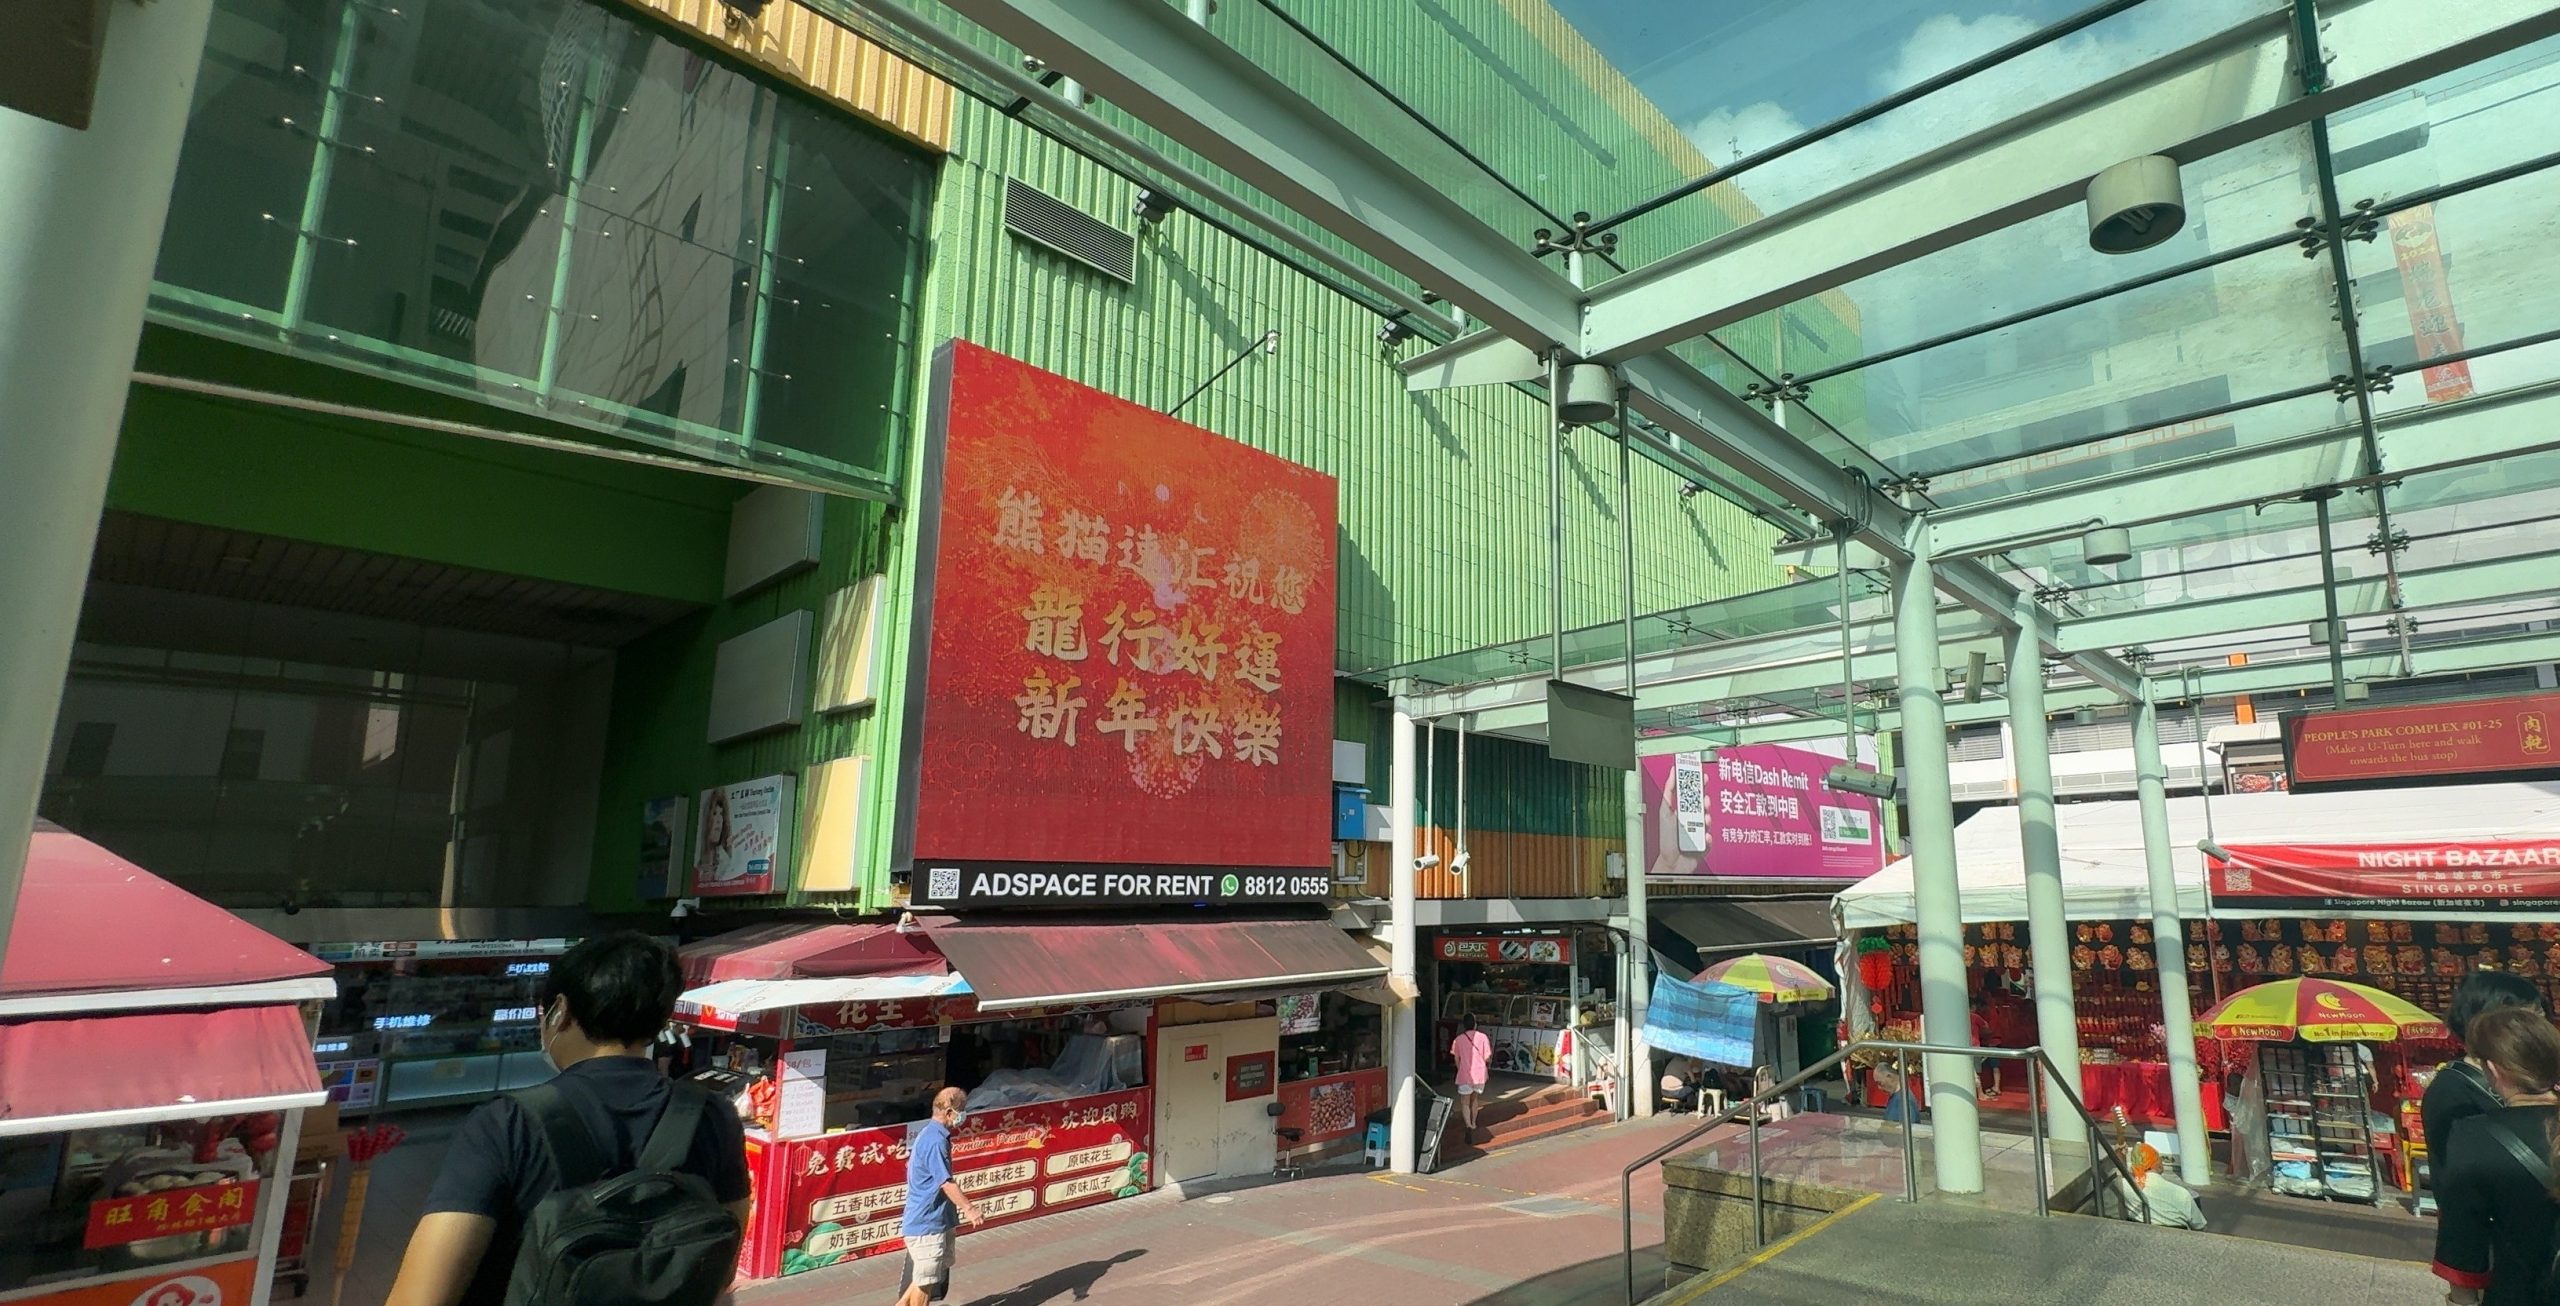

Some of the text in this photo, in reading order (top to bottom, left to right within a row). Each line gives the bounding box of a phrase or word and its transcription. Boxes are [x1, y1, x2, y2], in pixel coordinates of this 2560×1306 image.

[993, 484, 1307, 615] 熊猫速汇祝您
[1021, 581, 1284, 695] 龍行好運
[1014, 667, 1283, 767] 新年快樂
[2304, 718, 2503, 743] PEOPLE'S PARK COMPLEX #01-25
[2522, 715, 2548, 751] 肉乾
[2325, 742, 2356, 755] (Make
[2367, 741, 2406, 752] U-Turn
[2409, 739, 2431, 749] here
[2434, 736, 2454, 747] and
[2456, 735, 2482, 745] walk
[2350, 750, 2458, 765] towards the bus stop)
[1718, 756, 1780, 788] 新电信Dash
[1781, 768, 1809, 791] Remit
[1720, 789, 1799, 821] 安全汇款到中国
[2357, 848, 2560, 868] NIGHT BAZAAR
[970, 873, 1329, 897] ADSPACE FOR RENT 8812 0555
[2416, 871, 2503, 881] 新加坡夜市
[2402, 883, 2524, 894] SINGAPORE
[2377, 899, 2399, 907] Night
[2512, 899, 2560, 907] singapore
[373, 1013, 432, 1030] 手机维修
[837, 1000, 905, 1025] 花生
[2318, 1011, 2366, 1020] NewMoon
[2239, 1027, 2283, 1038] NewMoon
[1060, 1100, 1137, 1131] 欢迎团购
[1067, 1149, 1113, 1168] 原味花生
[1065, 1175, 1111, 1197] 原味瓜子
[832, 1188, 906, 1215] 五香味花生
